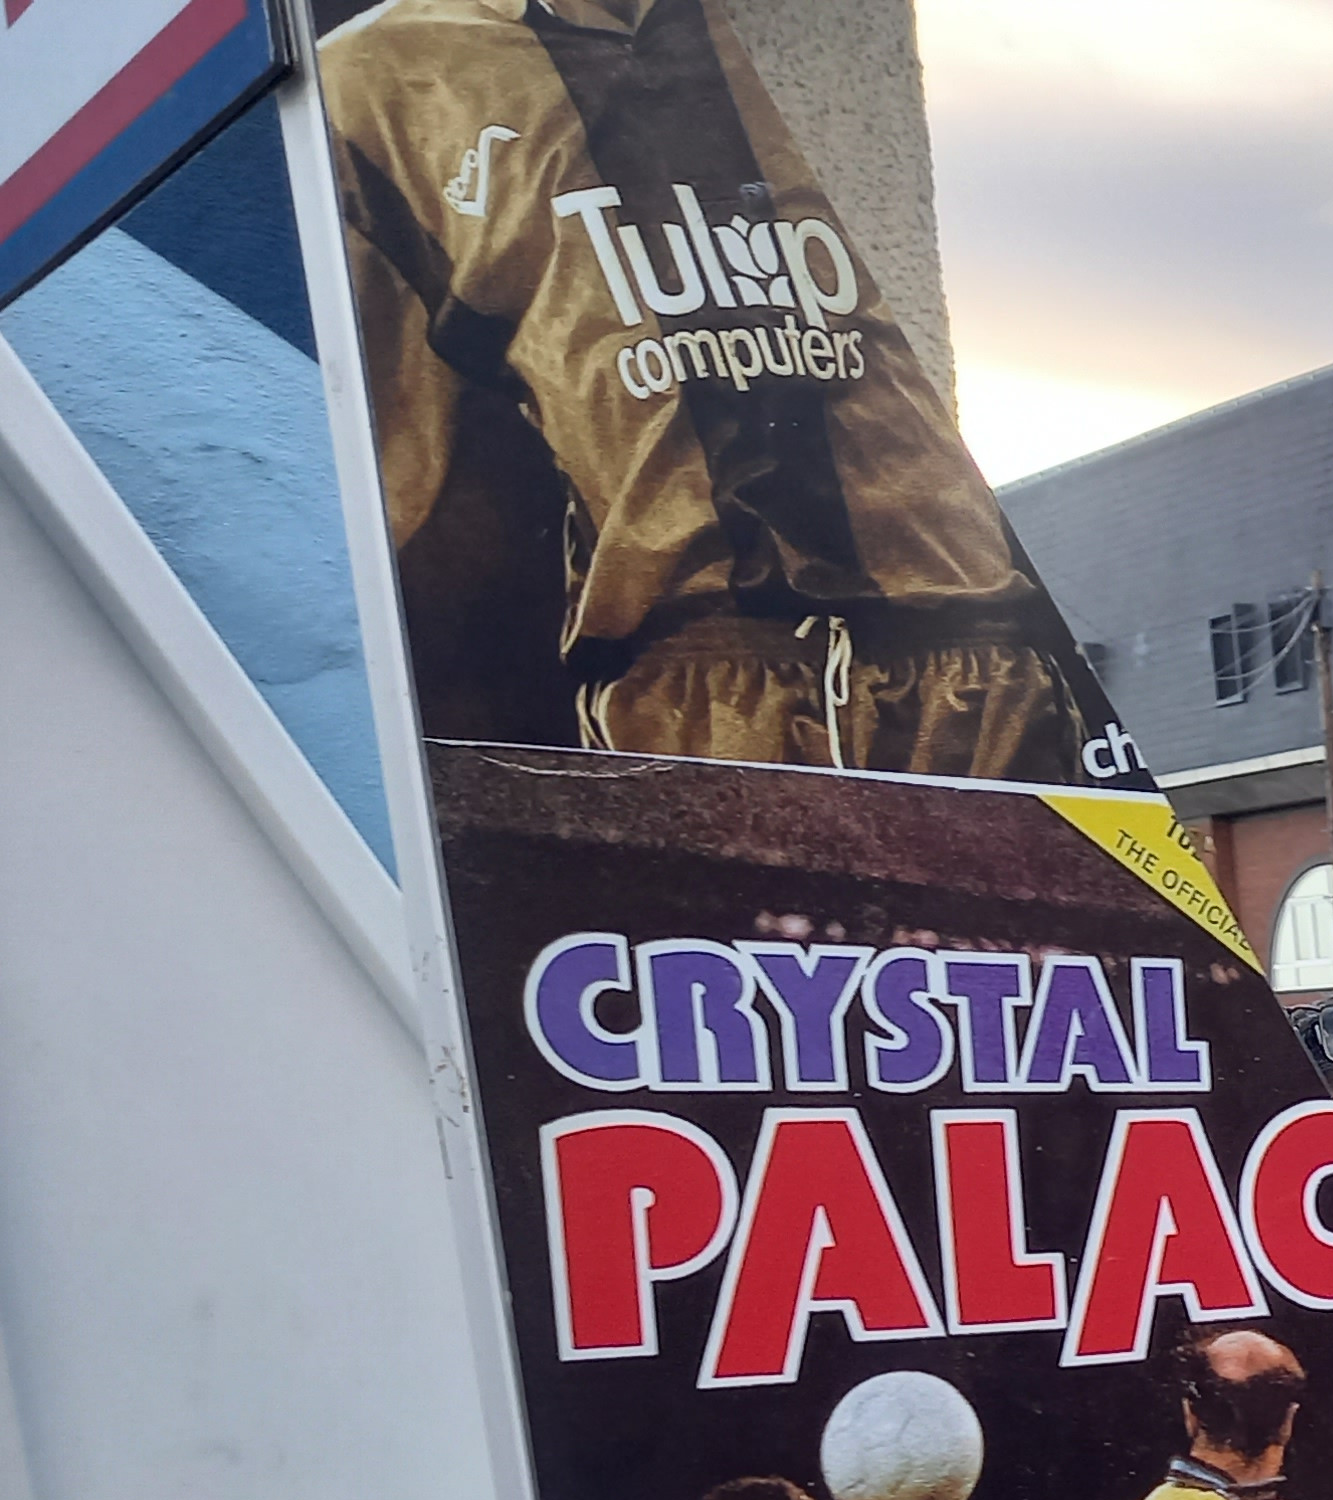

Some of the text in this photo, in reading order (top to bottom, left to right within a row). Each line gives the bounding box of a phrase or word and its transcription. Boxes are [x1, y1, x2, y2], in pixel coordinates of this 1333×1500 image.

[616, 320, 864, 399] computers
[1115, 829, 1160, 875] THE
[523, 931, 1211, 1094] CRYSTAL
